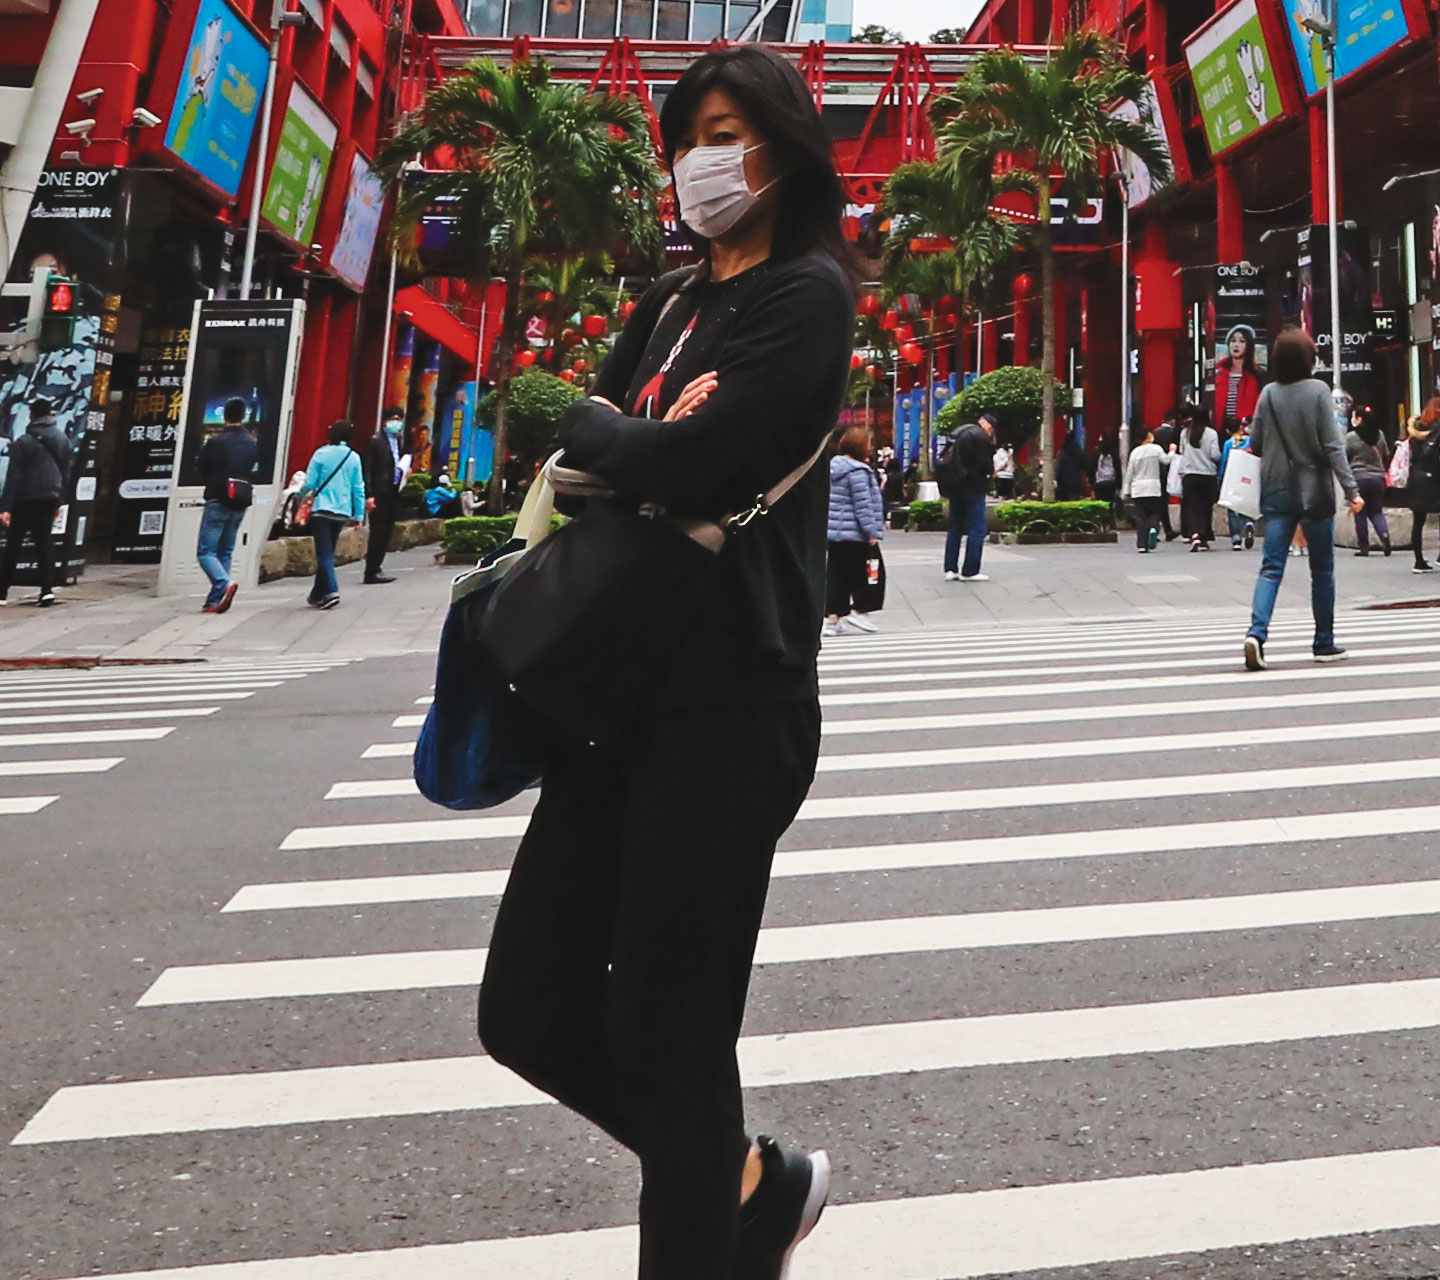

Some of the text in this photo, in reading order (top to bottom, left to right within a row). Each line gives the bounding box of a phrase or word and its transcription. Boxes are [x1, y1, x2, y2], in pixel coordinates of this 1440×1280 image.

[37, 171, 109, 187] ONE BOY
[1217, 266, 1260, 277] ONE BOY
[1316, 333, 1367, 345] ON BOY
